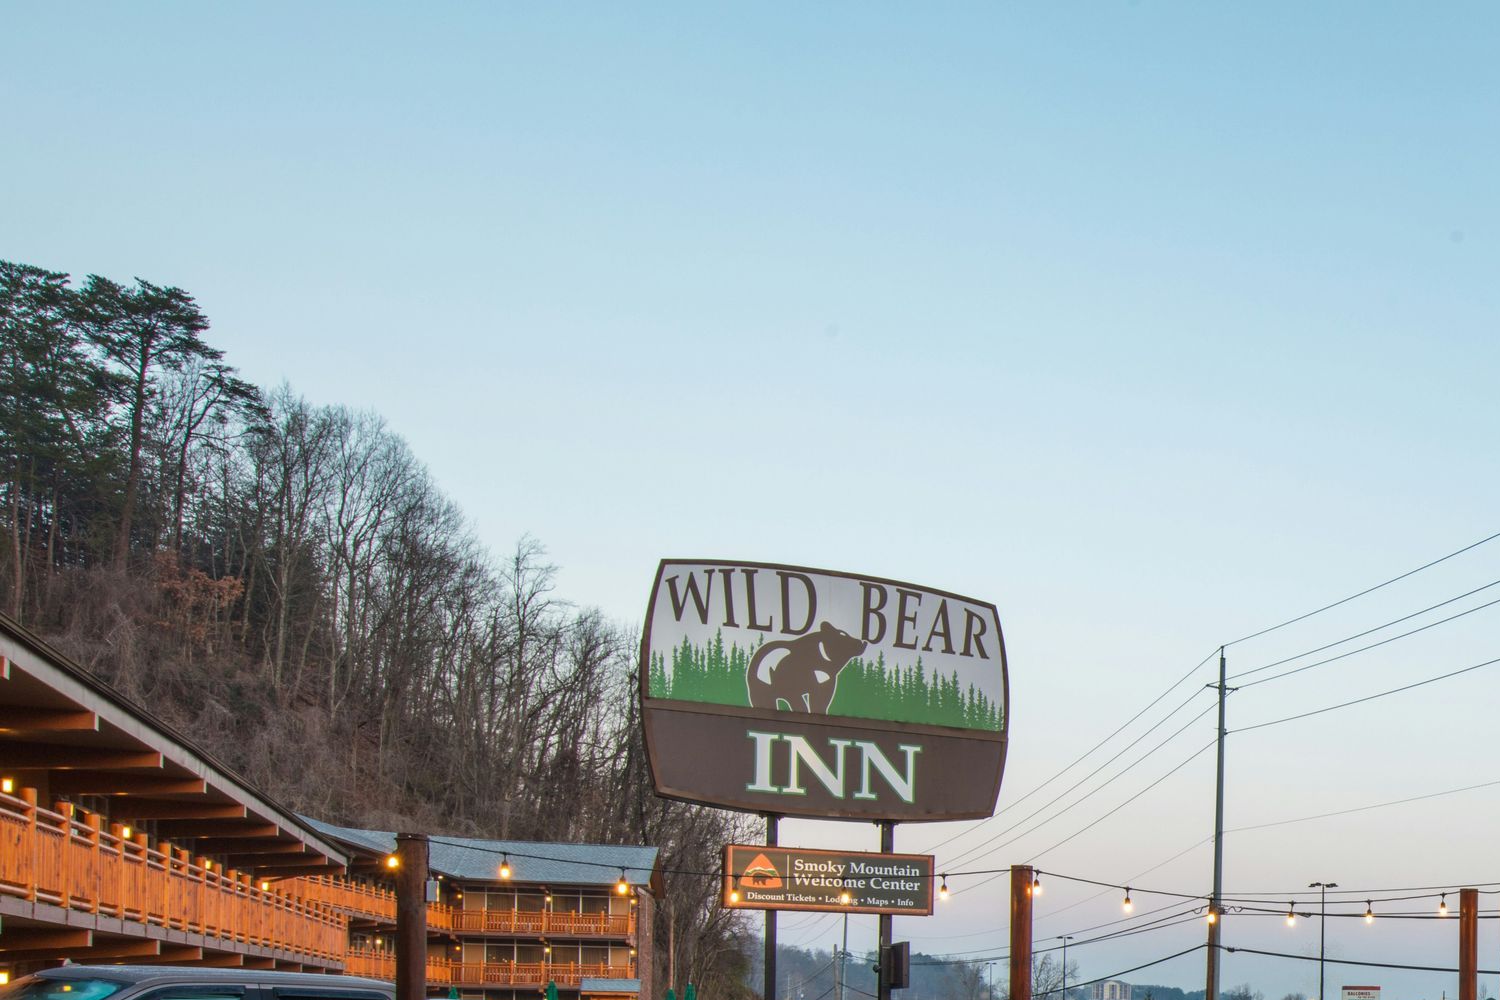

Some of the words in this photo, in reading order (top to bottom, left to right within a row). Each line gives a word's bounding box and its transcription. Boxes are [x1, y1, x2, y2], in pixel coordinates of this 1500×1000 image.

[665, 567, 817, 636] WILD
[859, 581, 990, 660] BEAR
[746, 731, 921, 803] INN
[794, 859, 845, 876] Smoky
[850, 862, 920, 877] Mountain
[793, 873, 866, 888] Welcome
[869, 877, 921, 891] Center
[747, 892, 784, 901] Discount
[786, 893, 816, 902] Tickets
[867, 897, 889, 906] Maps
[897, 898, 914, 907] Info
